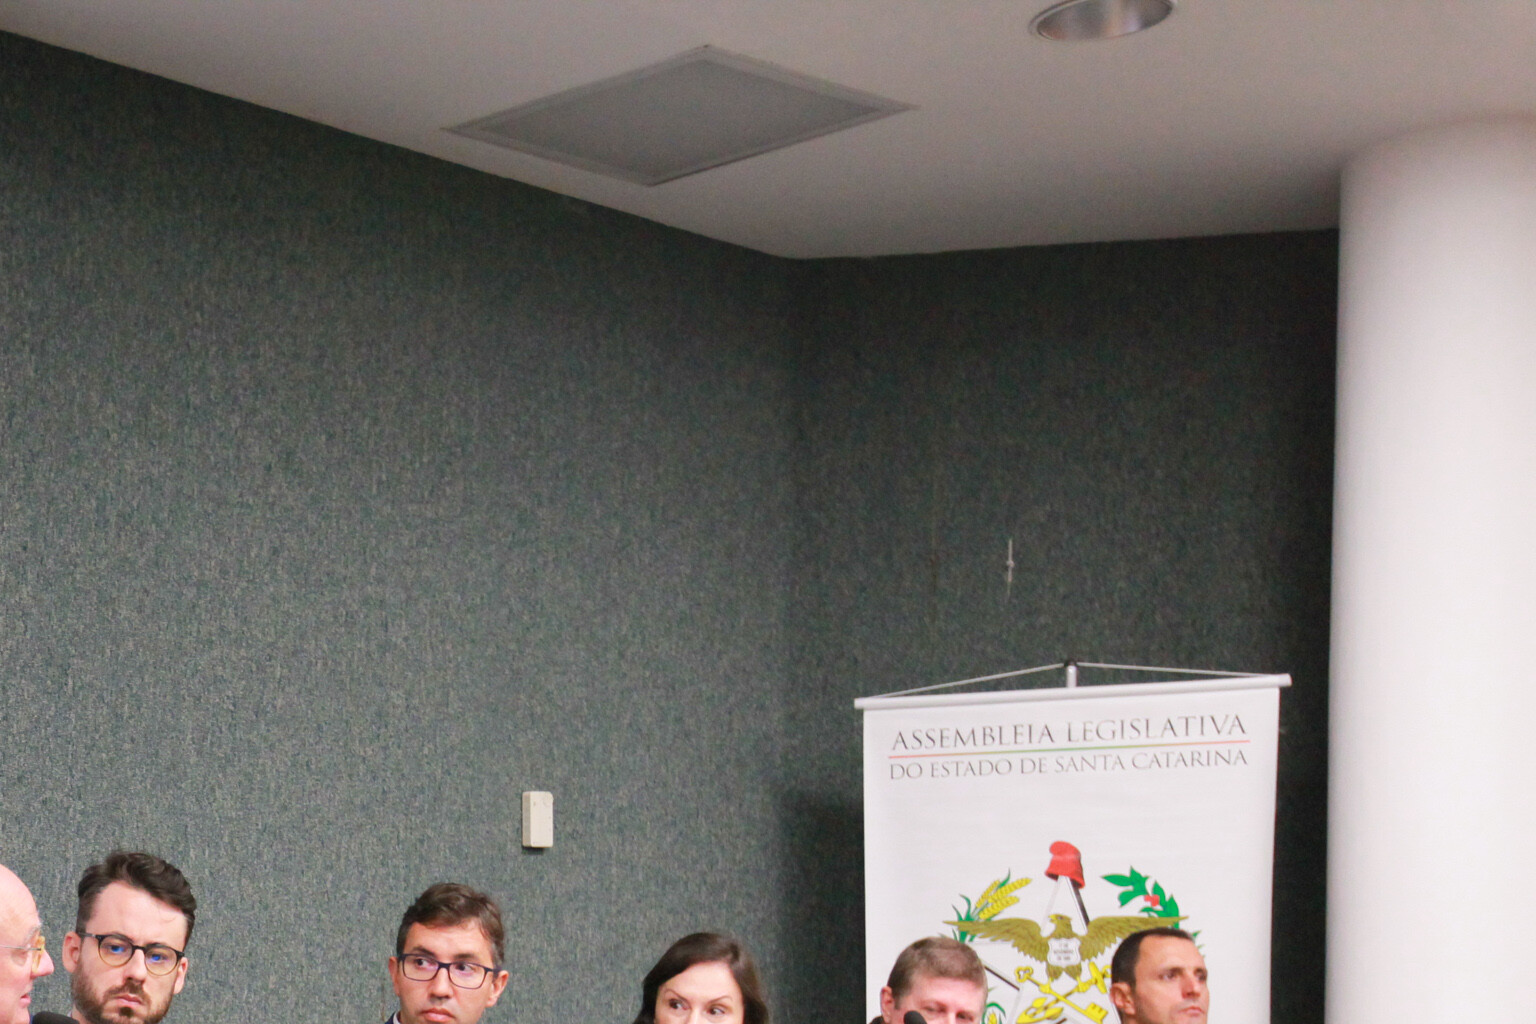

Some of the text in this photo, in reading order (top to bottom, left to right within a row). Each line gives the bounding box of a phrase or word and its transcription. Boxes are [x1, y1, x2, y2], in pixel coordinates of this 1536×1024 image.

[892, 714, 1247, 751] ASSEMBLEIA LEGISLATIVA
[890, 749, 1248, 780] DO ESTADO DE SANTA CATARINA
